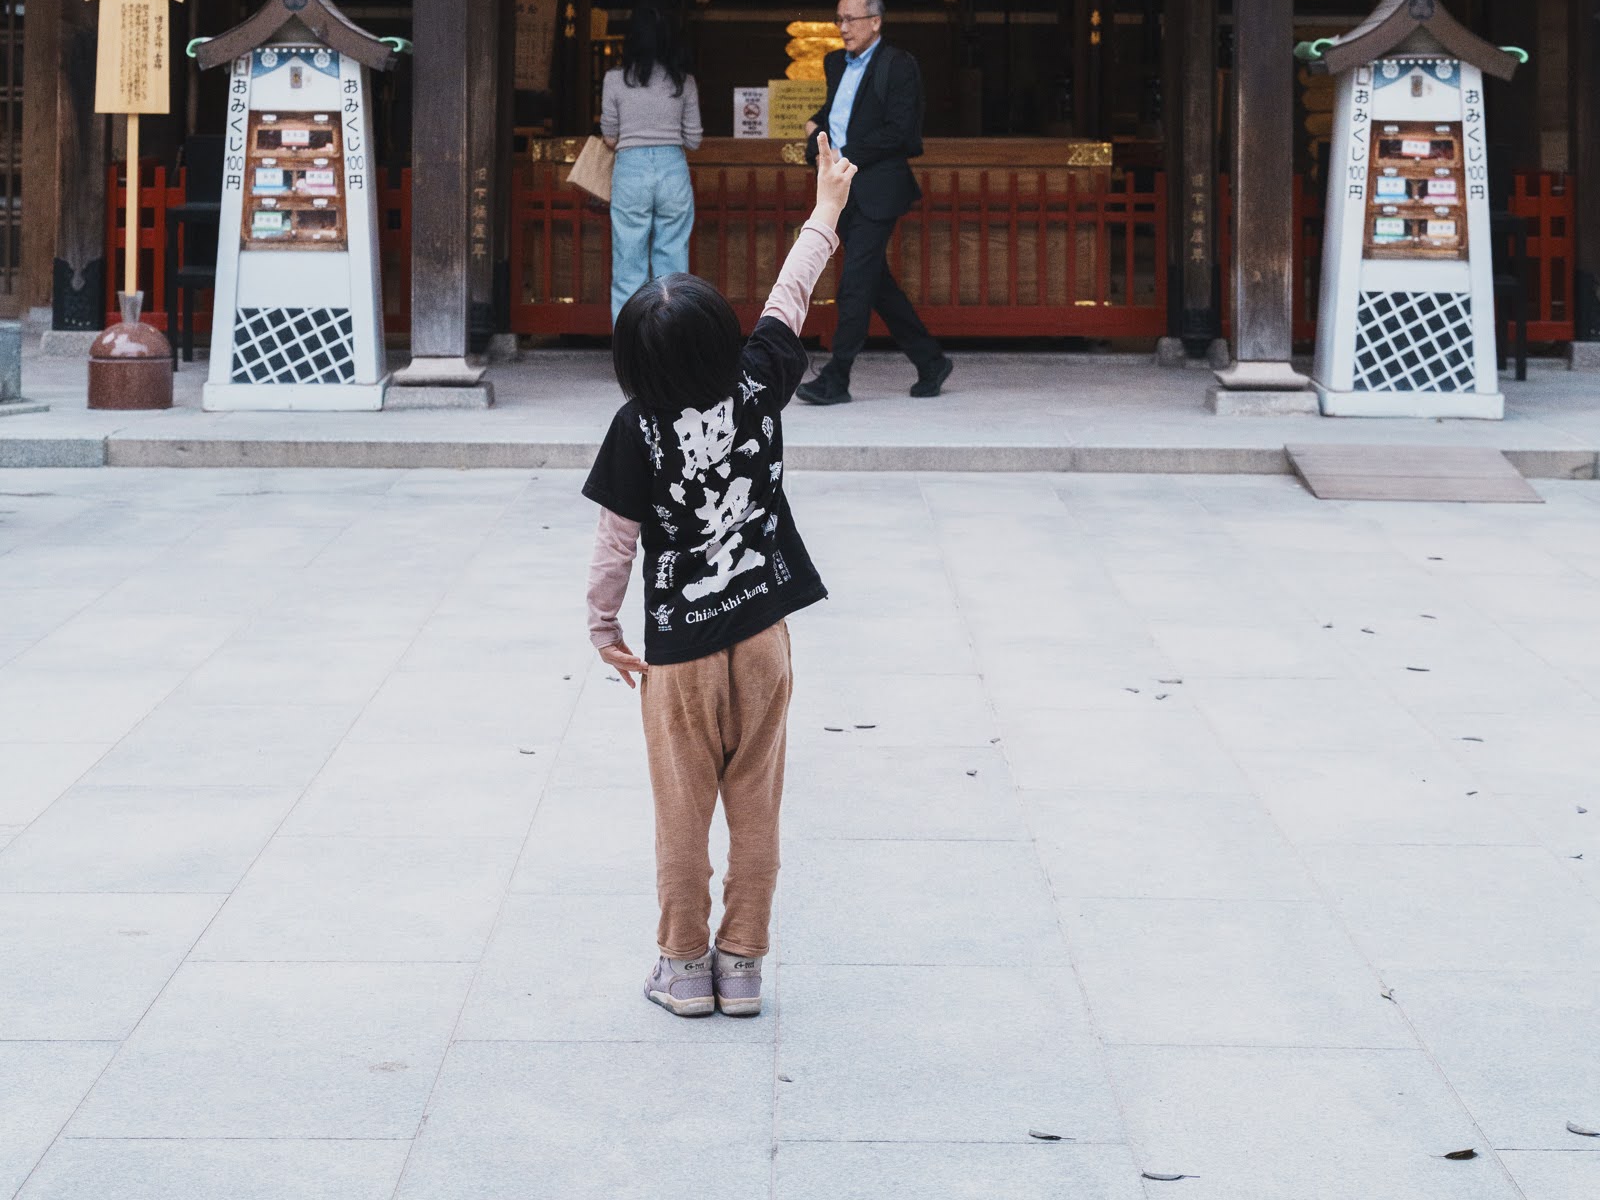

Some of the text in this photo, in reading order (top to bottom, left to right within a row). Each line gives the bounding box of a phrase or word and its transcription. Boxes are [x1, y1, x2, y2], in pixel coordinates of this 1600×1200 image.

[226, 80, 247, 190] おみくじ100円
[344, 79, 364, 190] おみくじ100円
[1348, 89, 1369, 200] おみくじ100円
[1465, 89, 1486, 200] おみくじ100円
